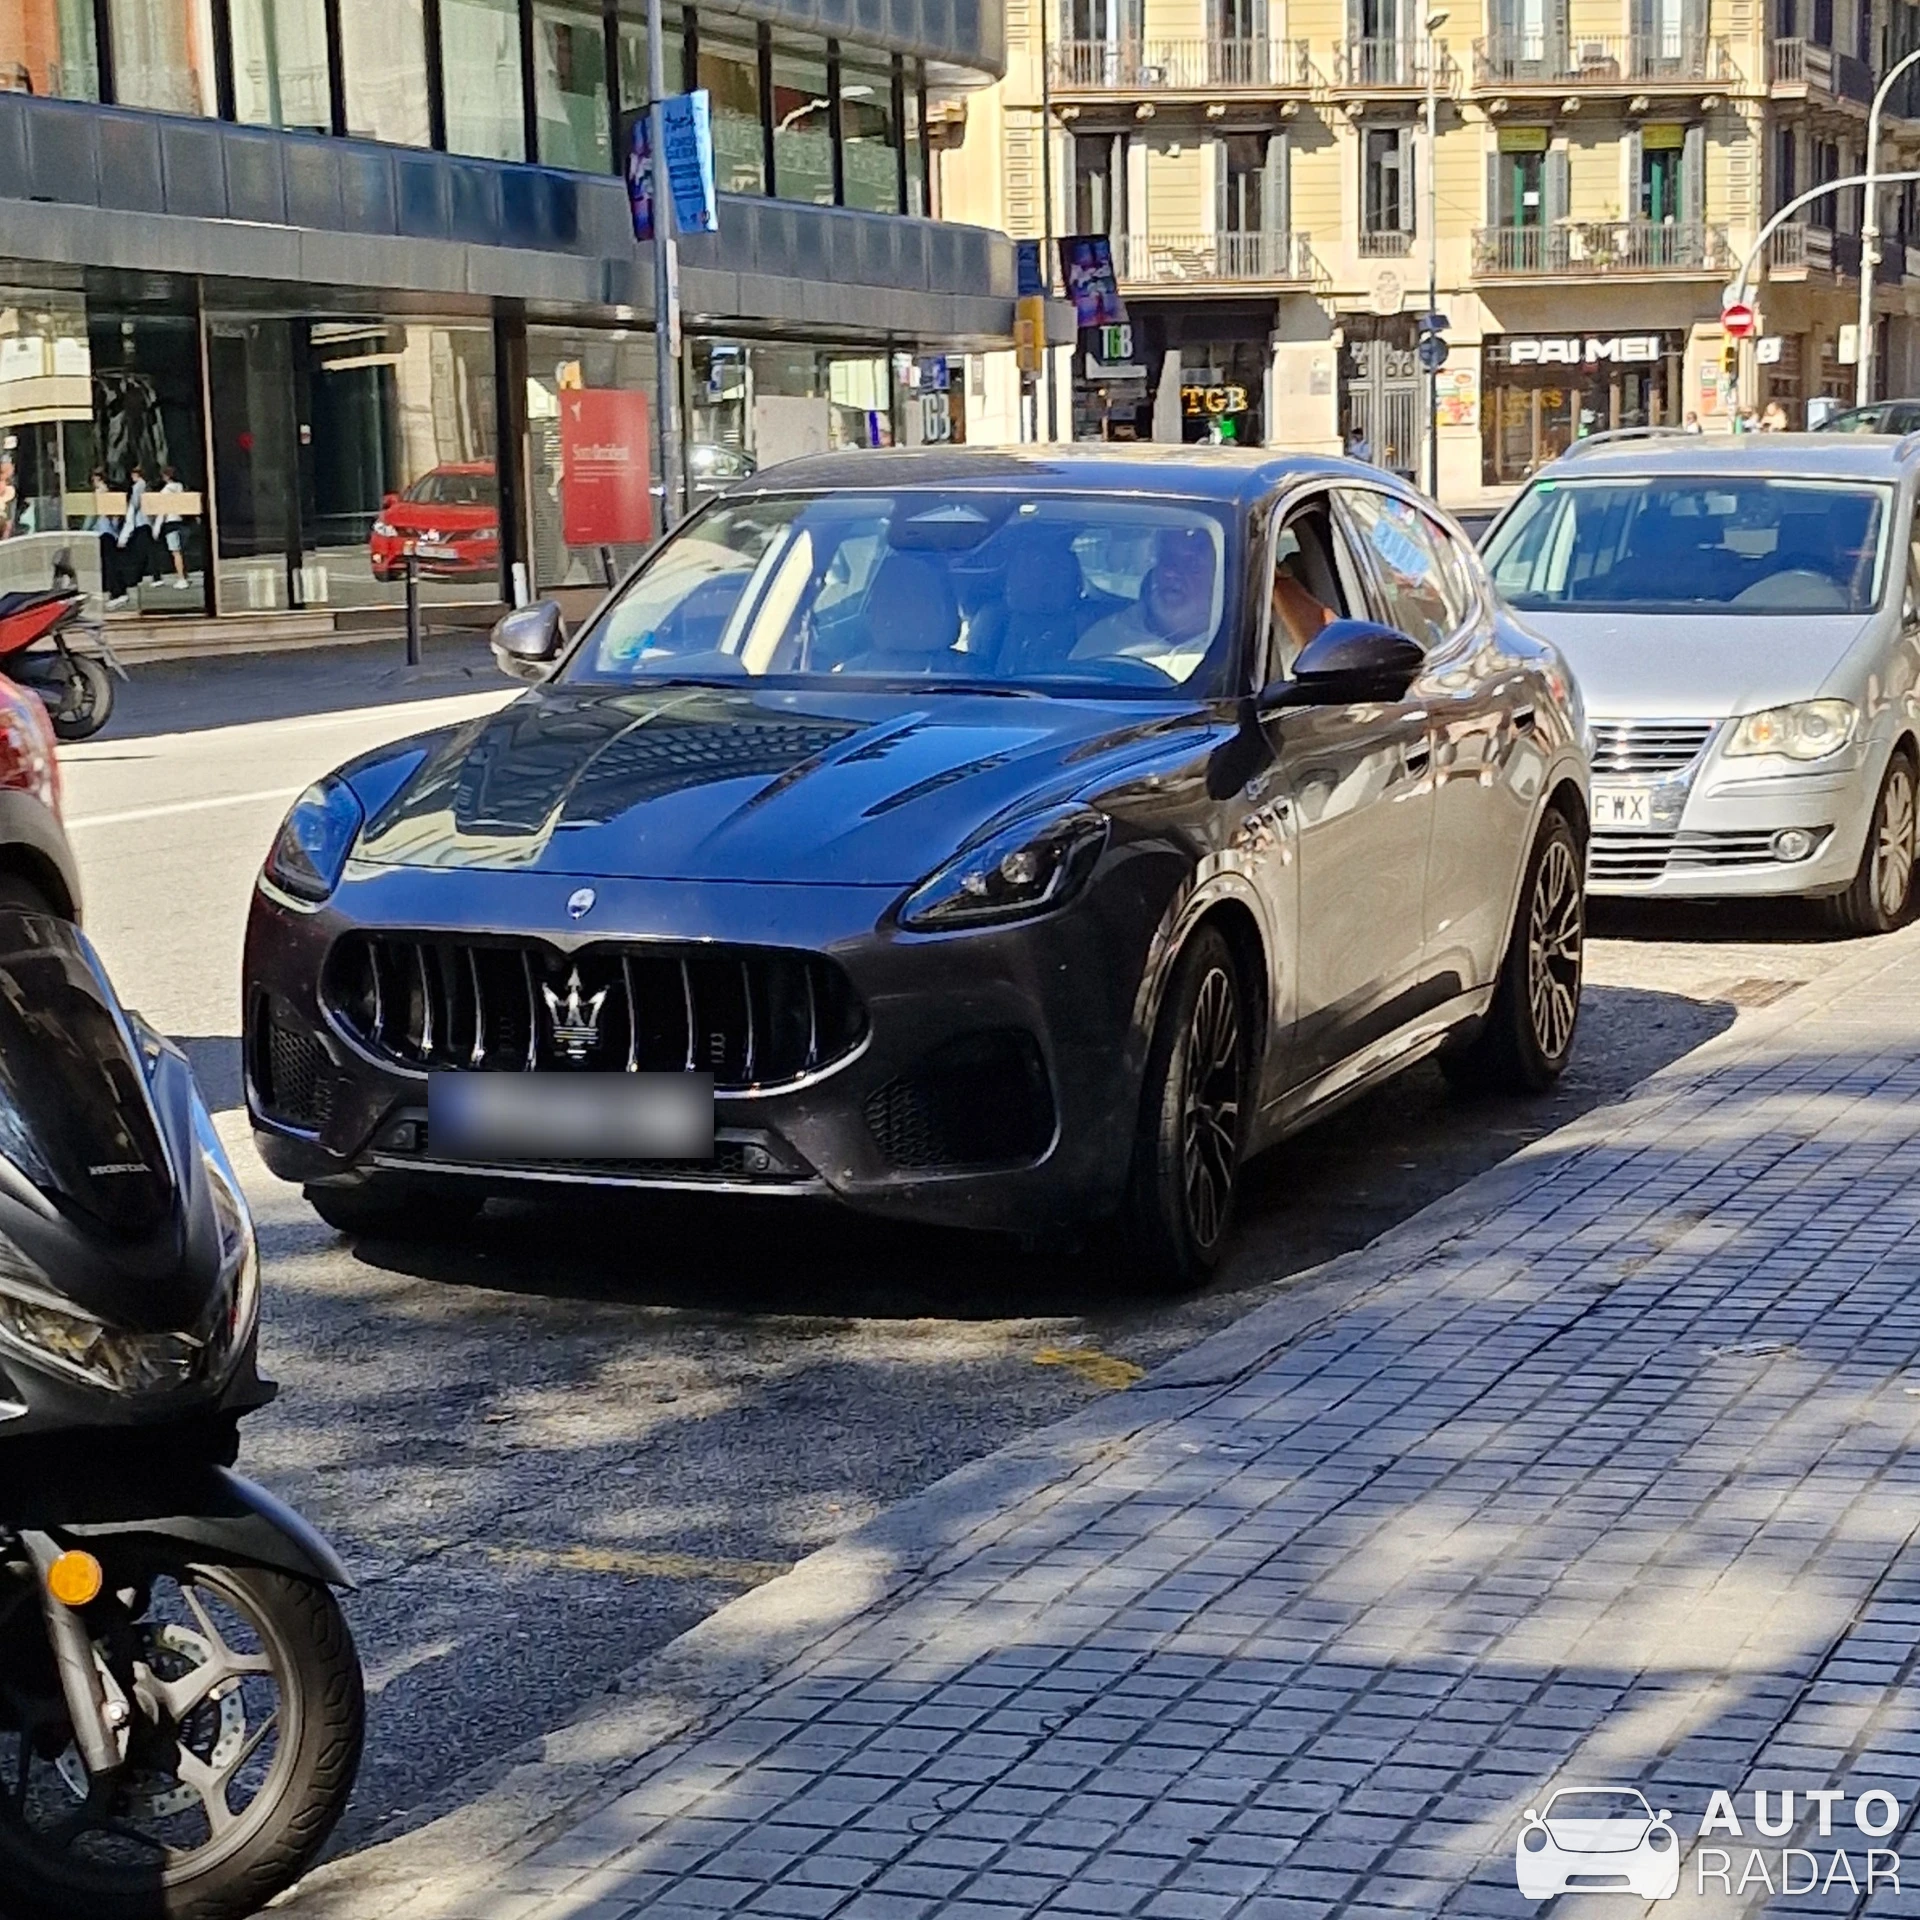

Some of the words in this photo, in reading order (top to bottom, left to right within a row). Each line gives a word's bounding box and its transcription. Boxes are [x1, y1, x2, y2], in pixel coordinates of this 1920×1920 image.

[1099, 324, 1133, 359] TGB
[1509, 339, 1580, 365] PAI
[1585, 336, 1660, 363] MEI
[1181, 385, 1249, 414] TGB
